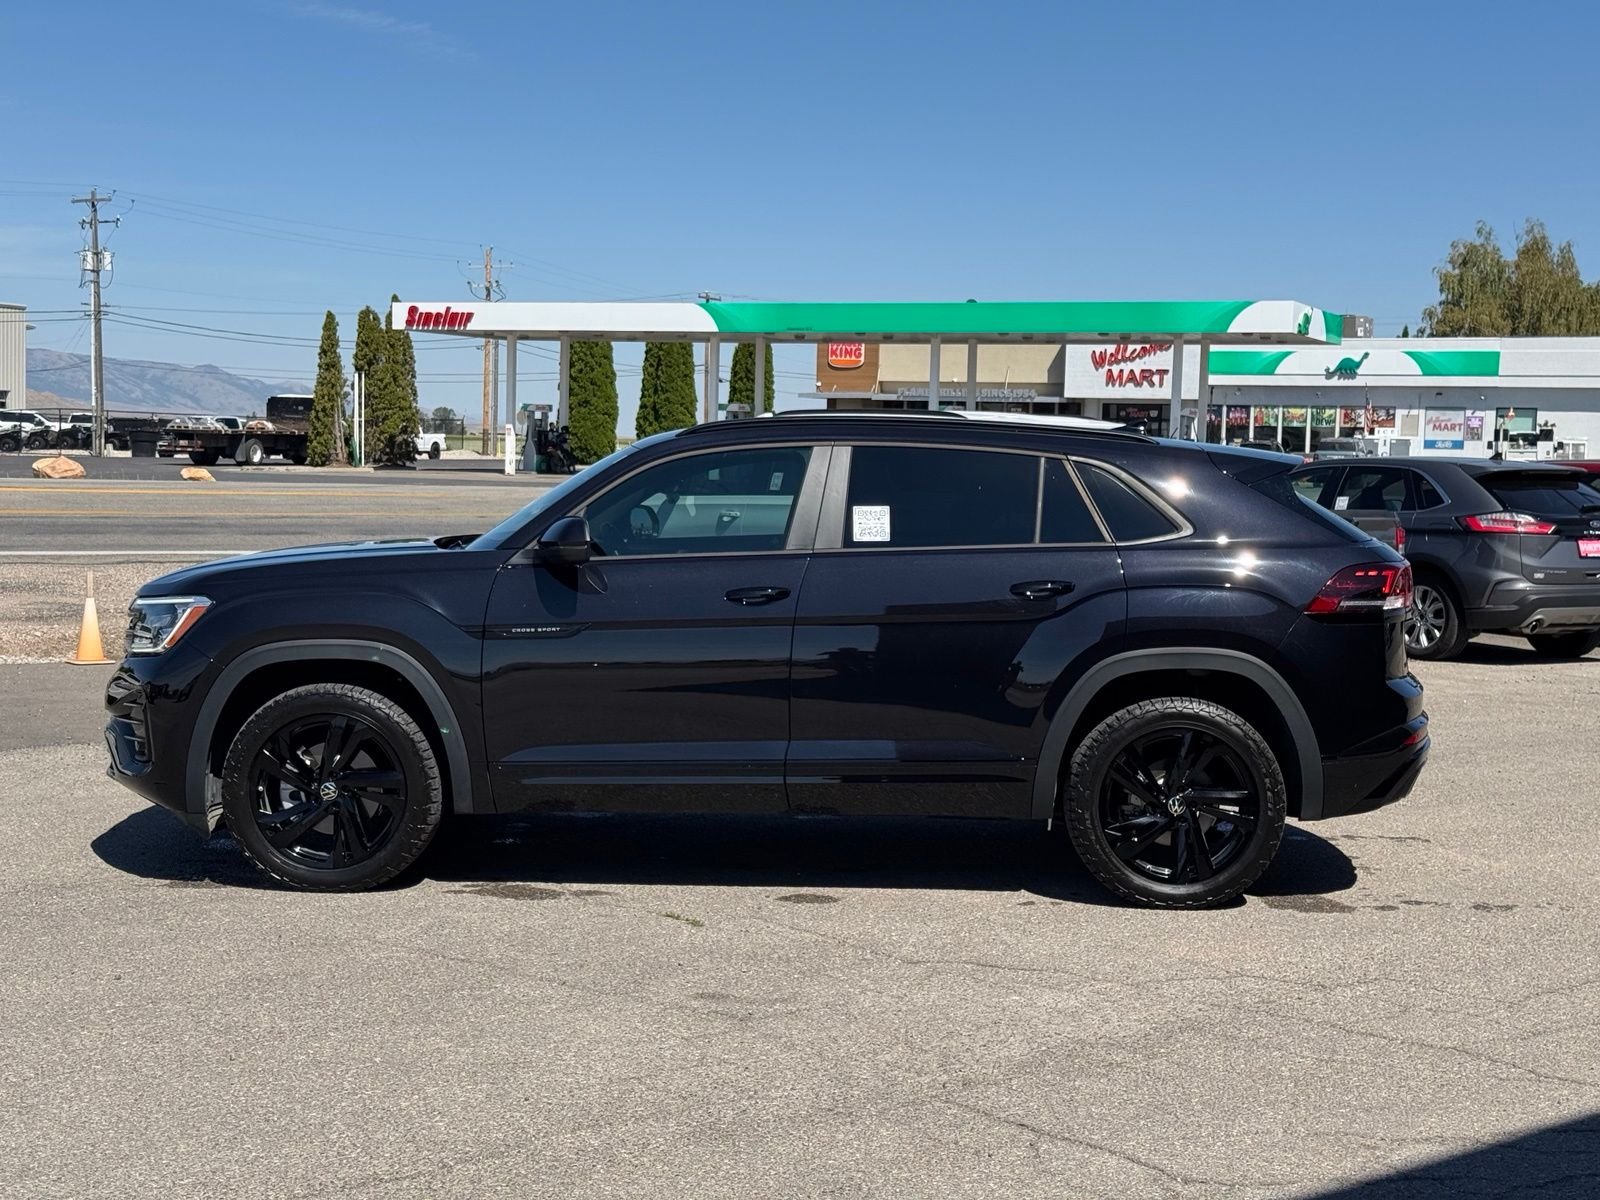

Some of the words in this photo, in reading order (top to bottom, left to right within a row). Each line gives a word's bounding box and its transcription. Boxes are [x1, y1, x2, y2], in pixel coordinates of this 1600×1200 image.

[405, 305, 474, 328] Sinclair
[830, 347, 862, 359] KING
[1105, 369, 1169, 388] MART
[1432, 423, 1463, 432] MART
